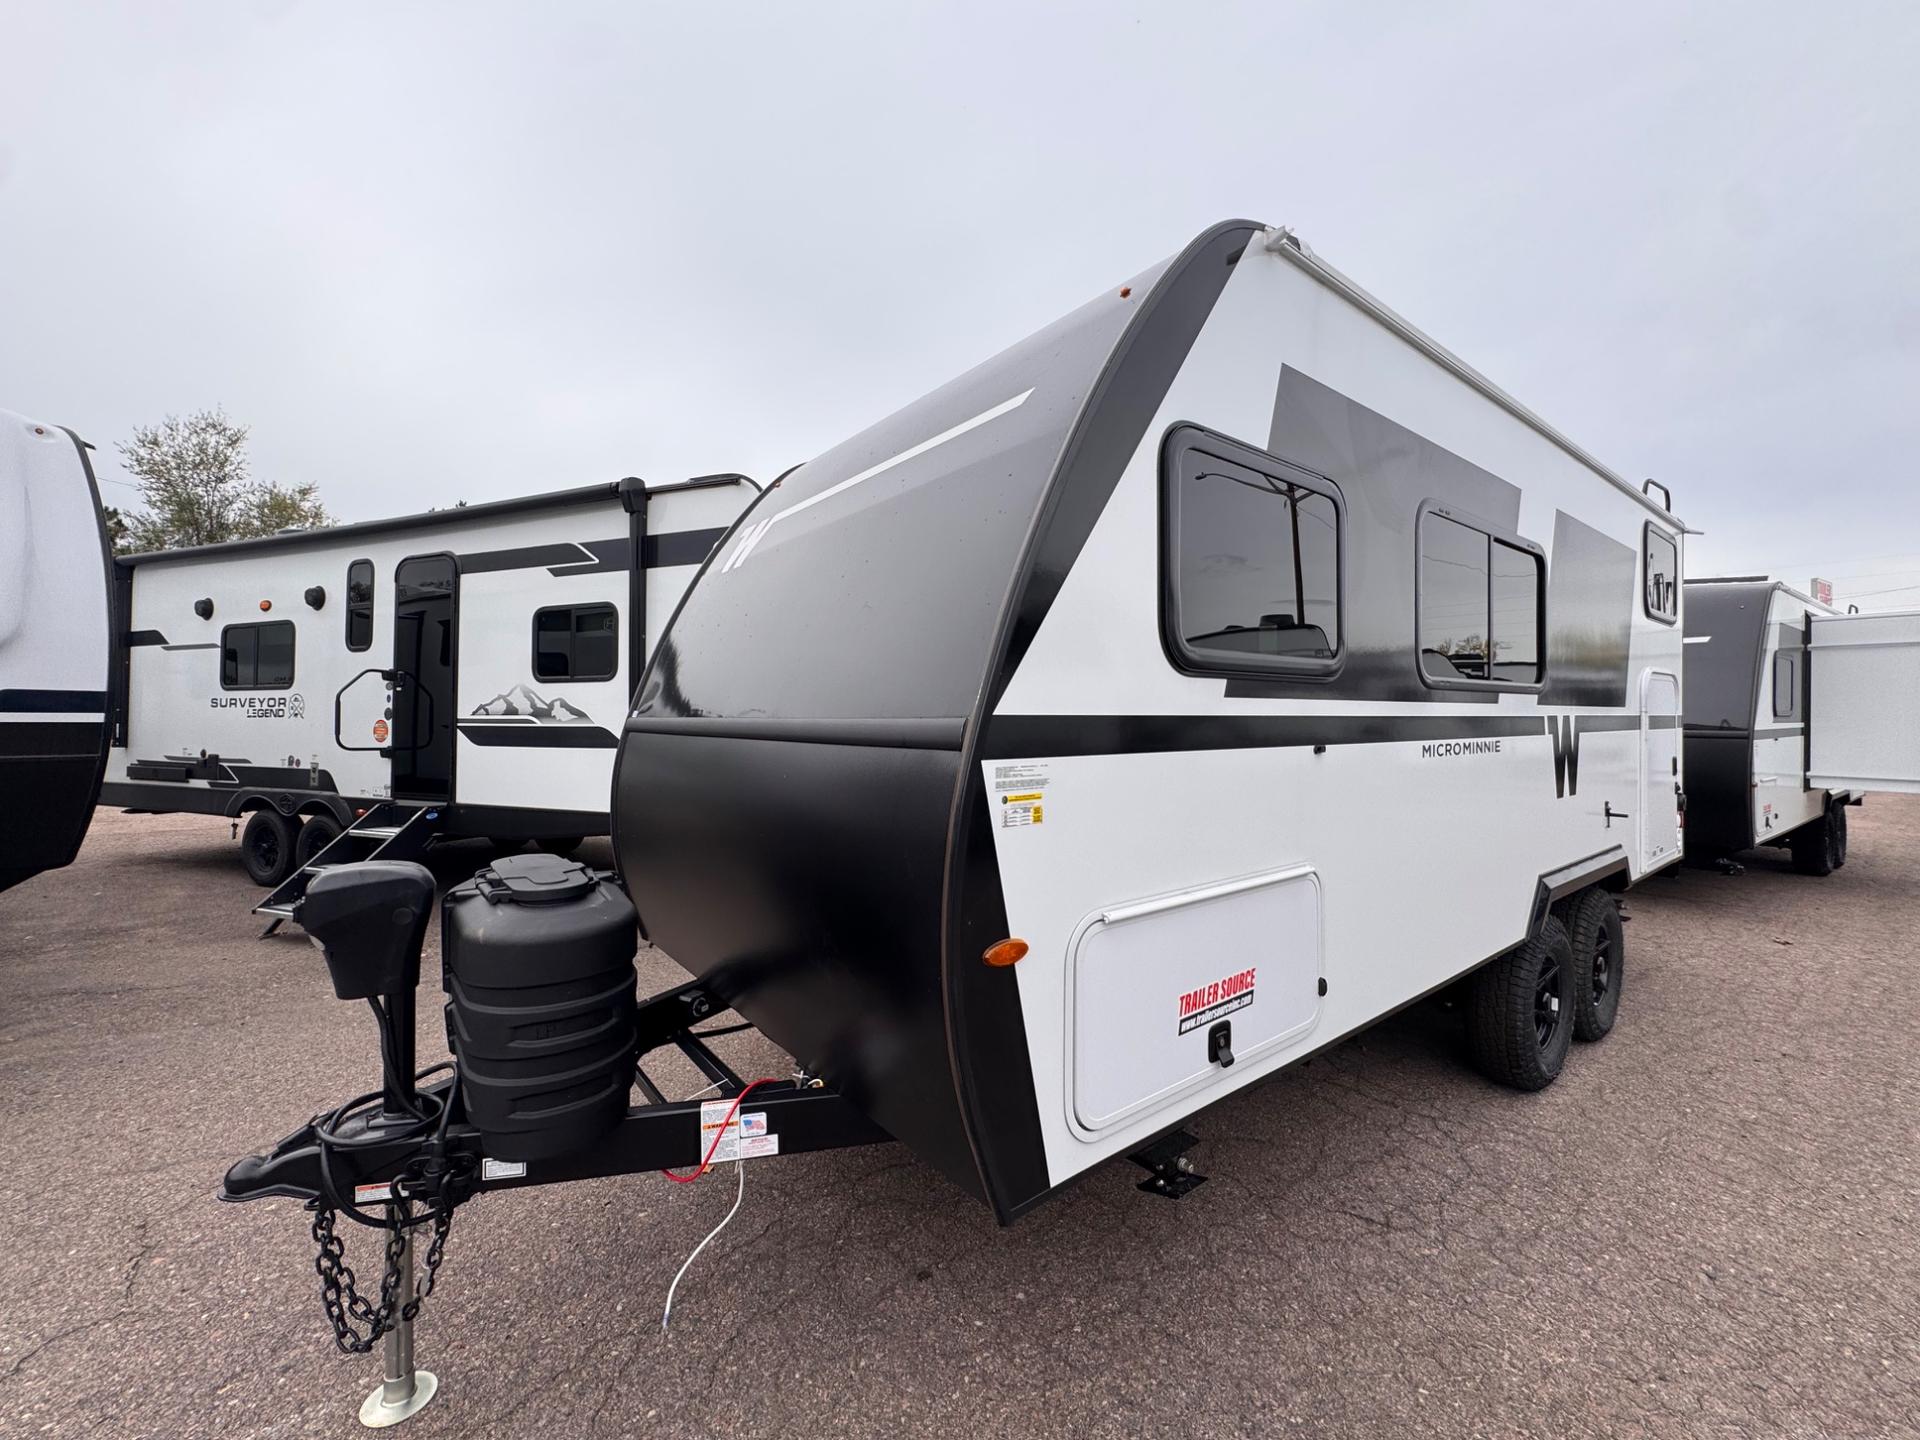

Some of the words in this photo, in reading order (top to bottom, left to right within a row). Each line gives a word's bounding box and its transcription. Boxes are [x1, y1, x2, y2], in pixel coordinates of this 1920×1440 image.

[210, 697, 287, 708] SURVEYOR
[246, 708, 285, 718] LEGEND
[1422, 740, 1501, 758] MICROMINNIE
[1179, 982, 1220, 1018] TRAILER
[1220, 967, 1256, 1000] SOURCE
